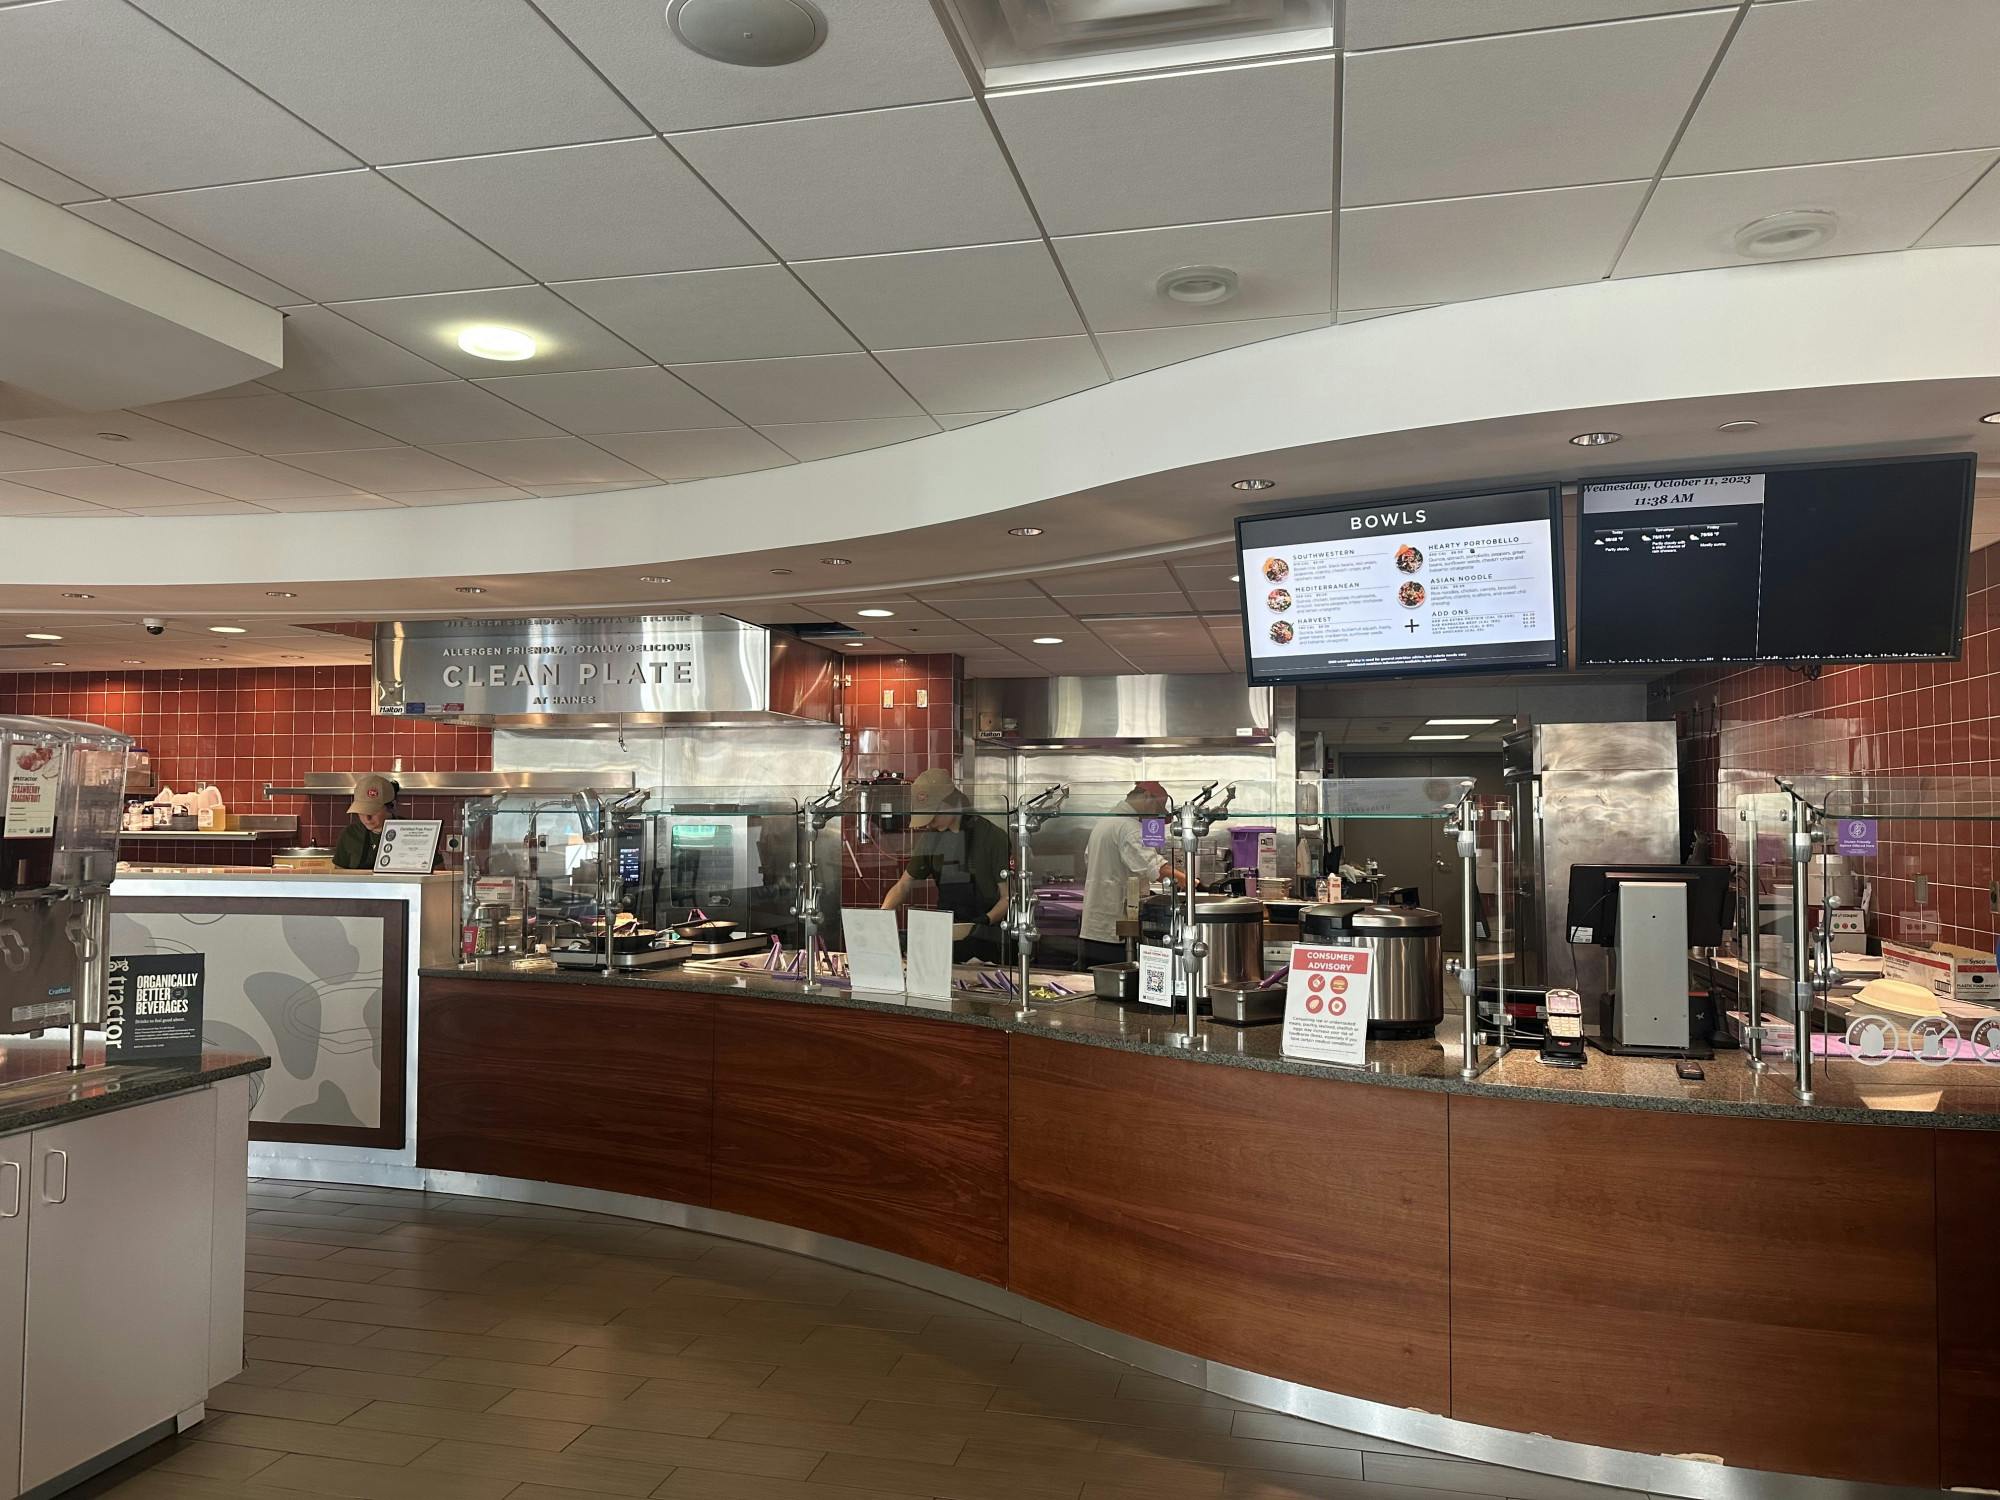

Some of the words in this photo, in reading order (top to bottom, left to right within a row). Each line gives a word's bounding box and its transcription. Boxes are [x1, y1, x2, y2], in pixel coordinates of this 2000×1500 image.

[1654, 478, 1701, 489] October
[1704, 478, 1718, 486] 11,
[1721, 475, 1751, 485] 2023
[1634, 493, 1668, 506] 11:38
[1671, 493, 1694, 504] AM
[1350, 510, 1427, 530] BOWLS
[1428, 542, 1460, 551] HEARTY
[1464, 536, 1519, 547] PORTOBELLO
[1292, 549, 1355, 560] SOUTHWESTERN
[1430, 576, 1455, 584] ASIAN
[1458, 573, 1493, 582] NOODLE
[1295, 582, 1360, 593] MEDITERRANEAN
[1297, 616, 1332, 624] HARVEST
[443, 647, 502, 657] ALLERGEN
[506, 645, 568, 656] FRIENDLY,
[571, 644, 622, 653] TOTALLY
[627, 642, 692, 653] DELICIOUS
[443, 663, 560, 688] CLEAN
[579, 661, 692, 686] PLATE
[532, 696, 548, 705] AT
[552, 695, 597, 705] HAINES
[1307, 951, 1355, 961] CONSUMER
[1307, 962, 1353, 971] ADVISORY
[136, 973, 198, 988] ORGANICALLY
[135, 988, 171, 1002] BETTER
[105, 975, 128, 1049] tractor
[135, 999, 189, 1015] BEVERAGES
